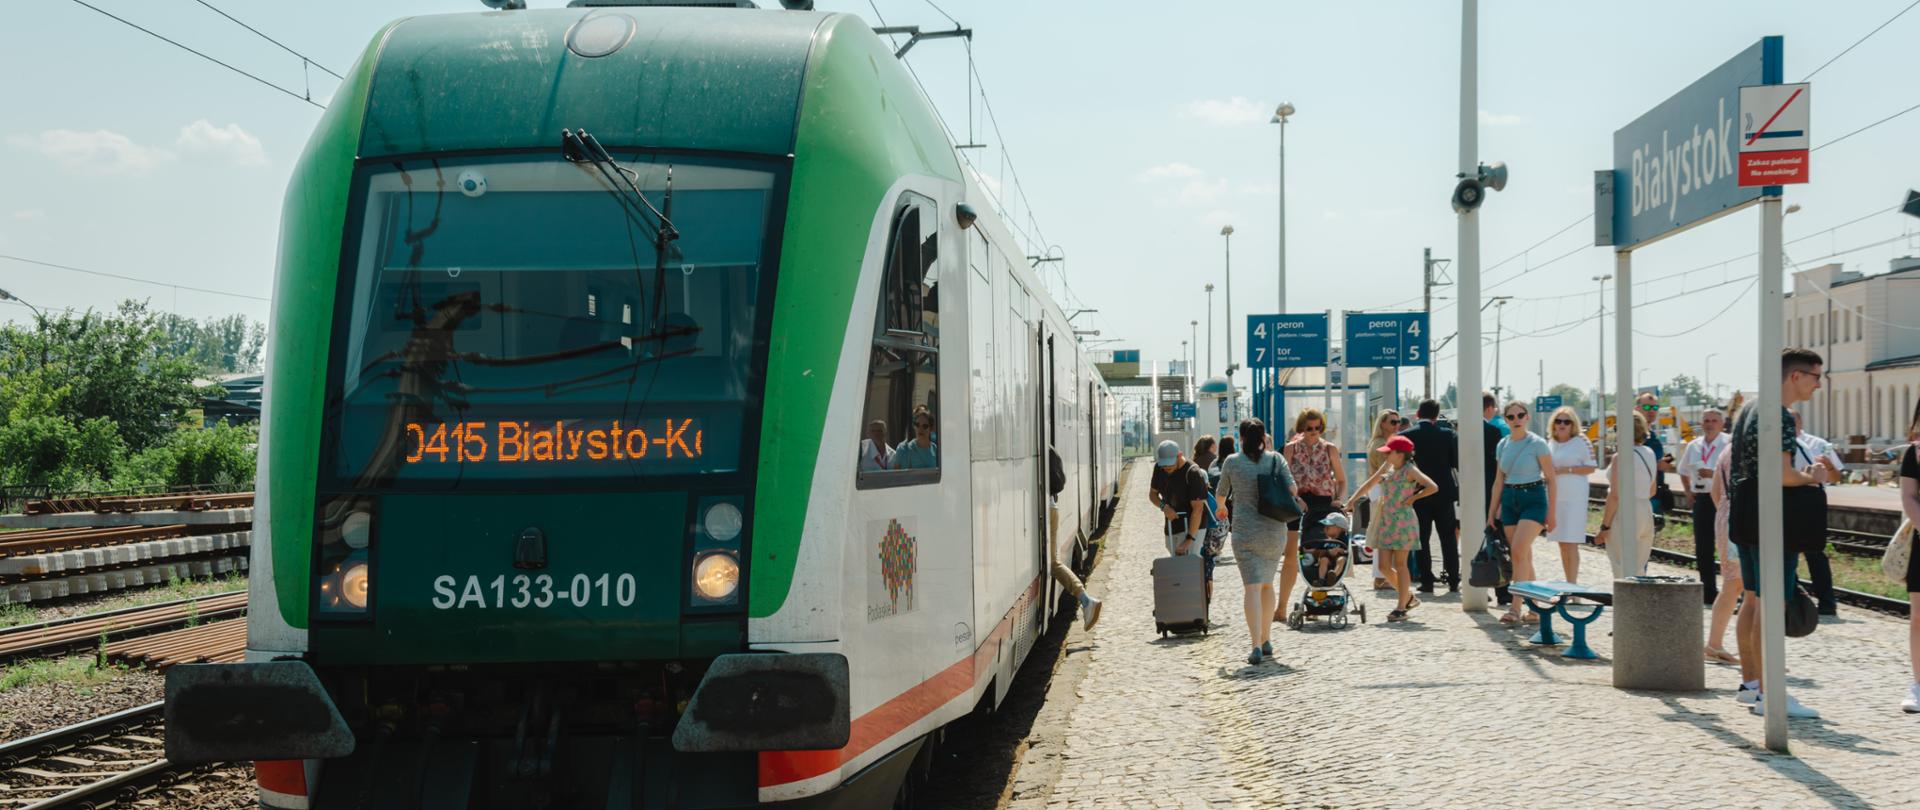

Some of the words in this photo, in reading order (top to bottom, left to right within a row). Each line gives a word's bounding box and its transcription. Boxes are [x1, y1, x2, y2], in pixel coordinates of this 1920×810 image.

[1632, 97, 1733, 222] Białystok
[1253, 322, 1267, 339] 4
[1277, 321, 1304, 331] peron
[1368, 320, 1397, 330] peron
[1407, 319, 1421, 337] 4
[1255, 347, 1266, 362] 7
[1277, 347, 1291, 355] tor
[1382, 346, 1397, 355] tor
[1409, 345, 1420, 361] 5
[406, 422, 488, 462] 0415
[432, 573, 636, 609] SA133-010
